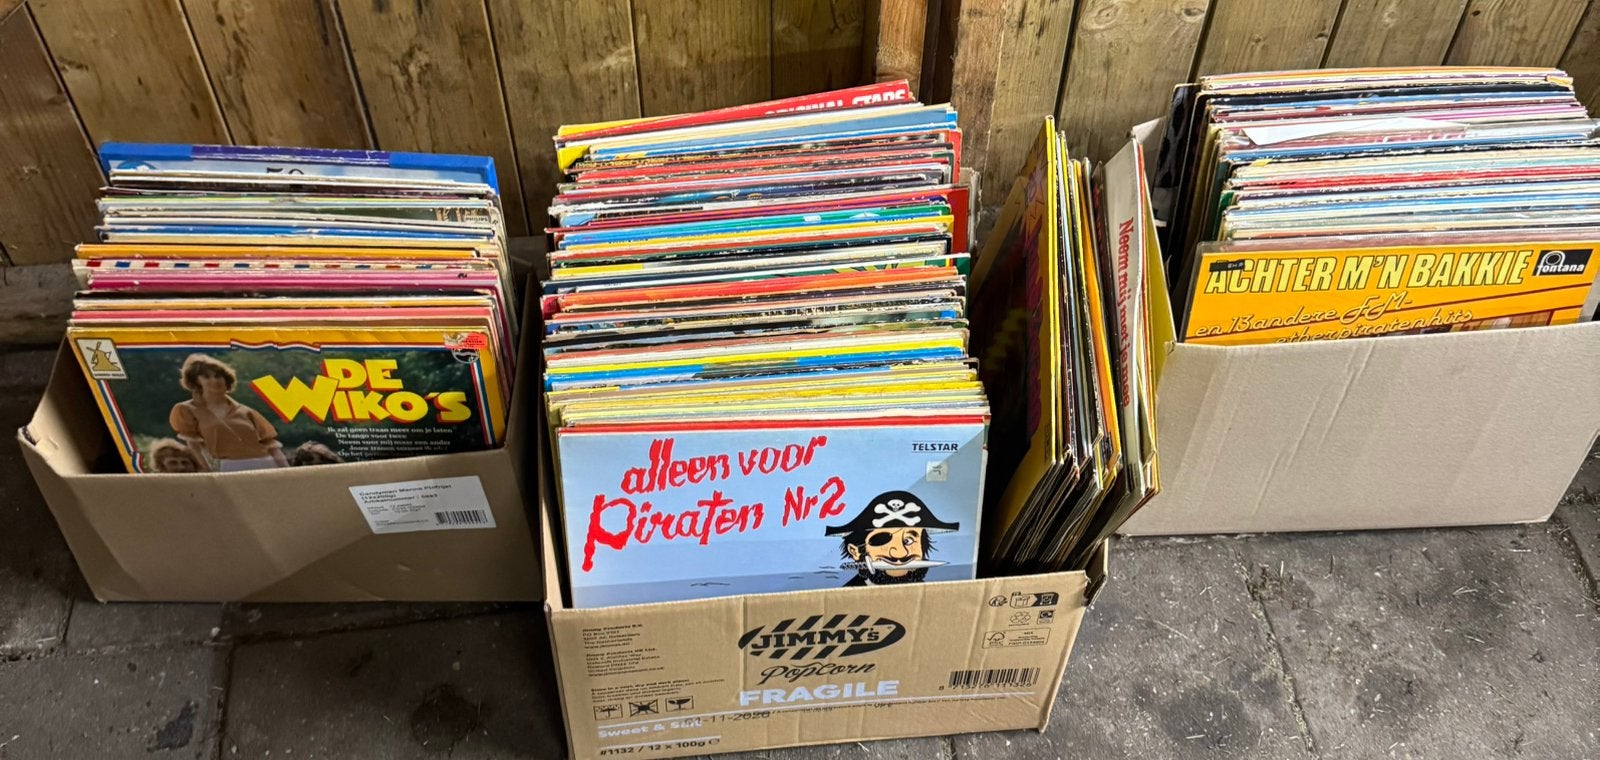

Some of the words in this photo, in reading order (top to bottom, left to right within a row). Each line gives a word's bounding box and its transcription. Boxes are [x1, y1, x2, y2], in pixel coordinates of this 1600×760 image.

[1118, 217, 1134, 271] Neem
[1204, 256, 1339, 293] ACHTER
[1406, 249, 1534, 288] BAKKIE
[1536, 250, 1586, 277] fontana
[1195, 326, 1221, 338] en
[1229, 313, 1254, 333] 13
[1252, 306, 1337, 331] andere
[322, 357, 406, 392] DE
[911, 443, 958, 451] TELSTAR
[620, 437, 729, 495] alleen
[738, 434, 828, 475] voor
[582, 490, 763, 572] Piraten
[739, 680, 900, 706] FRAGILE
[598, 726, 649, 738] Sweet
[653, 724, 666, 732] &
[600, 747, 634, 756] #1132
[676, 741, 706, 749] 100g
